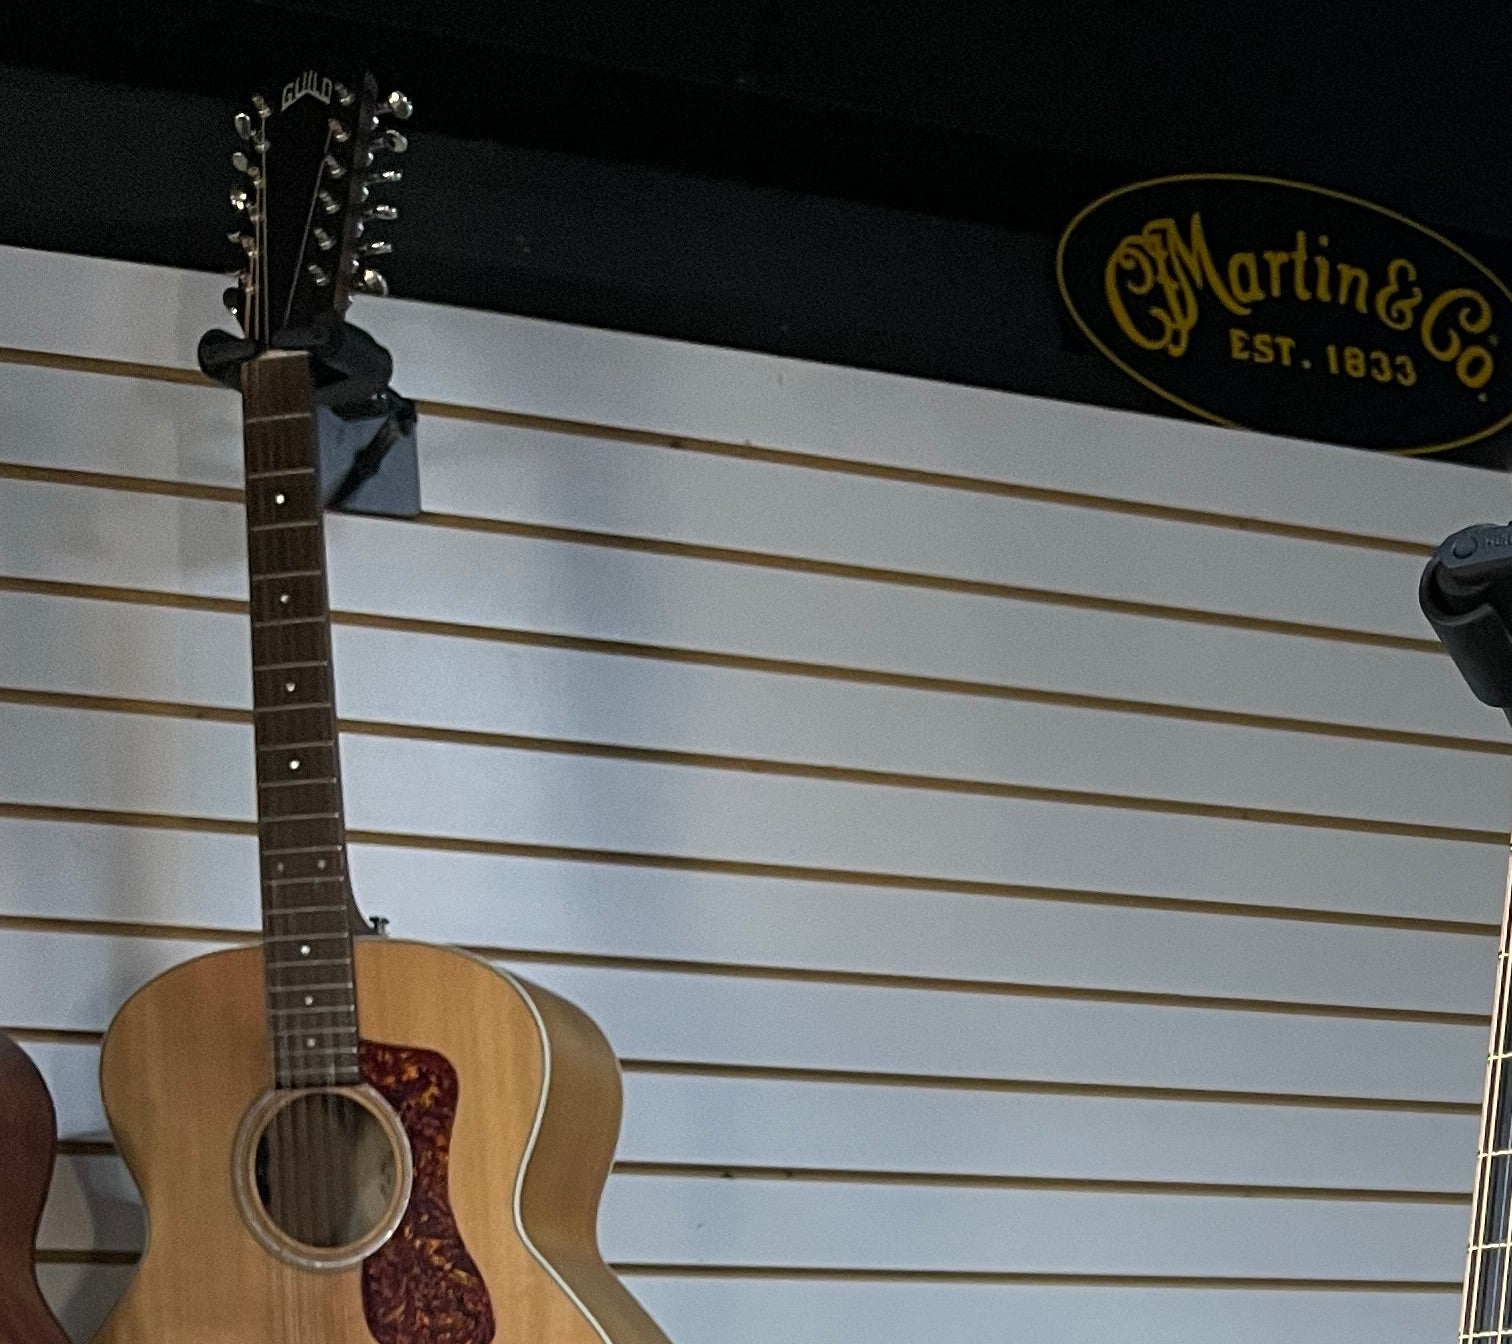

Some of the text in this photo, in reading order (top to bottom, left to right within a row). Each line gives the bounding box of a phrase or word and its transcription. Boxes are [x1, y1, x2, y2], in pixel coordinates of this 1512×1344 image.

[281, 70, 332, 111] GUILD
[1228, 328, 1417, 387] EST. 1833
